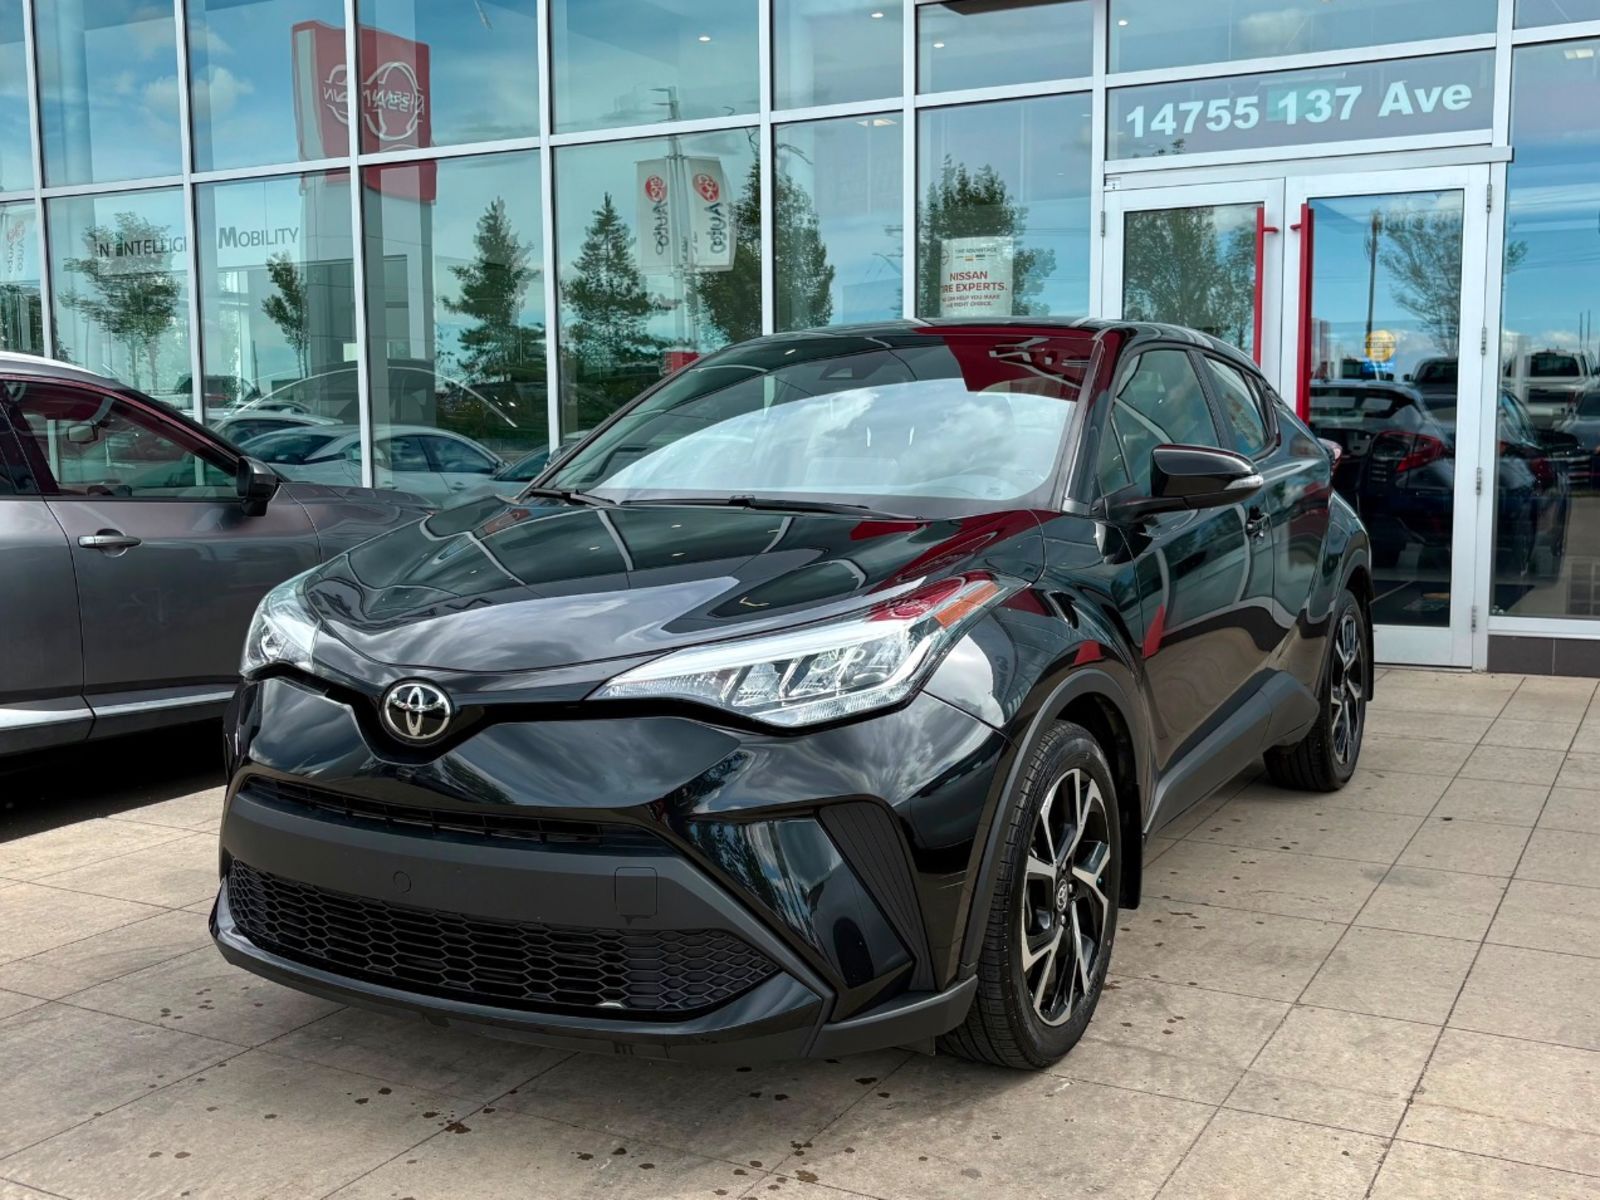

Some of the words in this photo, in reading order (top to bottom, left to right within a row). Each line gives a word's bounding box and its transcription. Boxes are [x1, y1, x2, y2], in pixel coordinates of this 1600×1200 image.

[1126, 96, 1259, 138] 14755
[1278, 86, 1362, 125] 137
[1378, 82, 1473, 117] Ave
[218, 226, 299, 249] MOBILITY
[949, 270, 988, 281] NISSAN
[956, 282, 1008, 293] EXPERTS.
